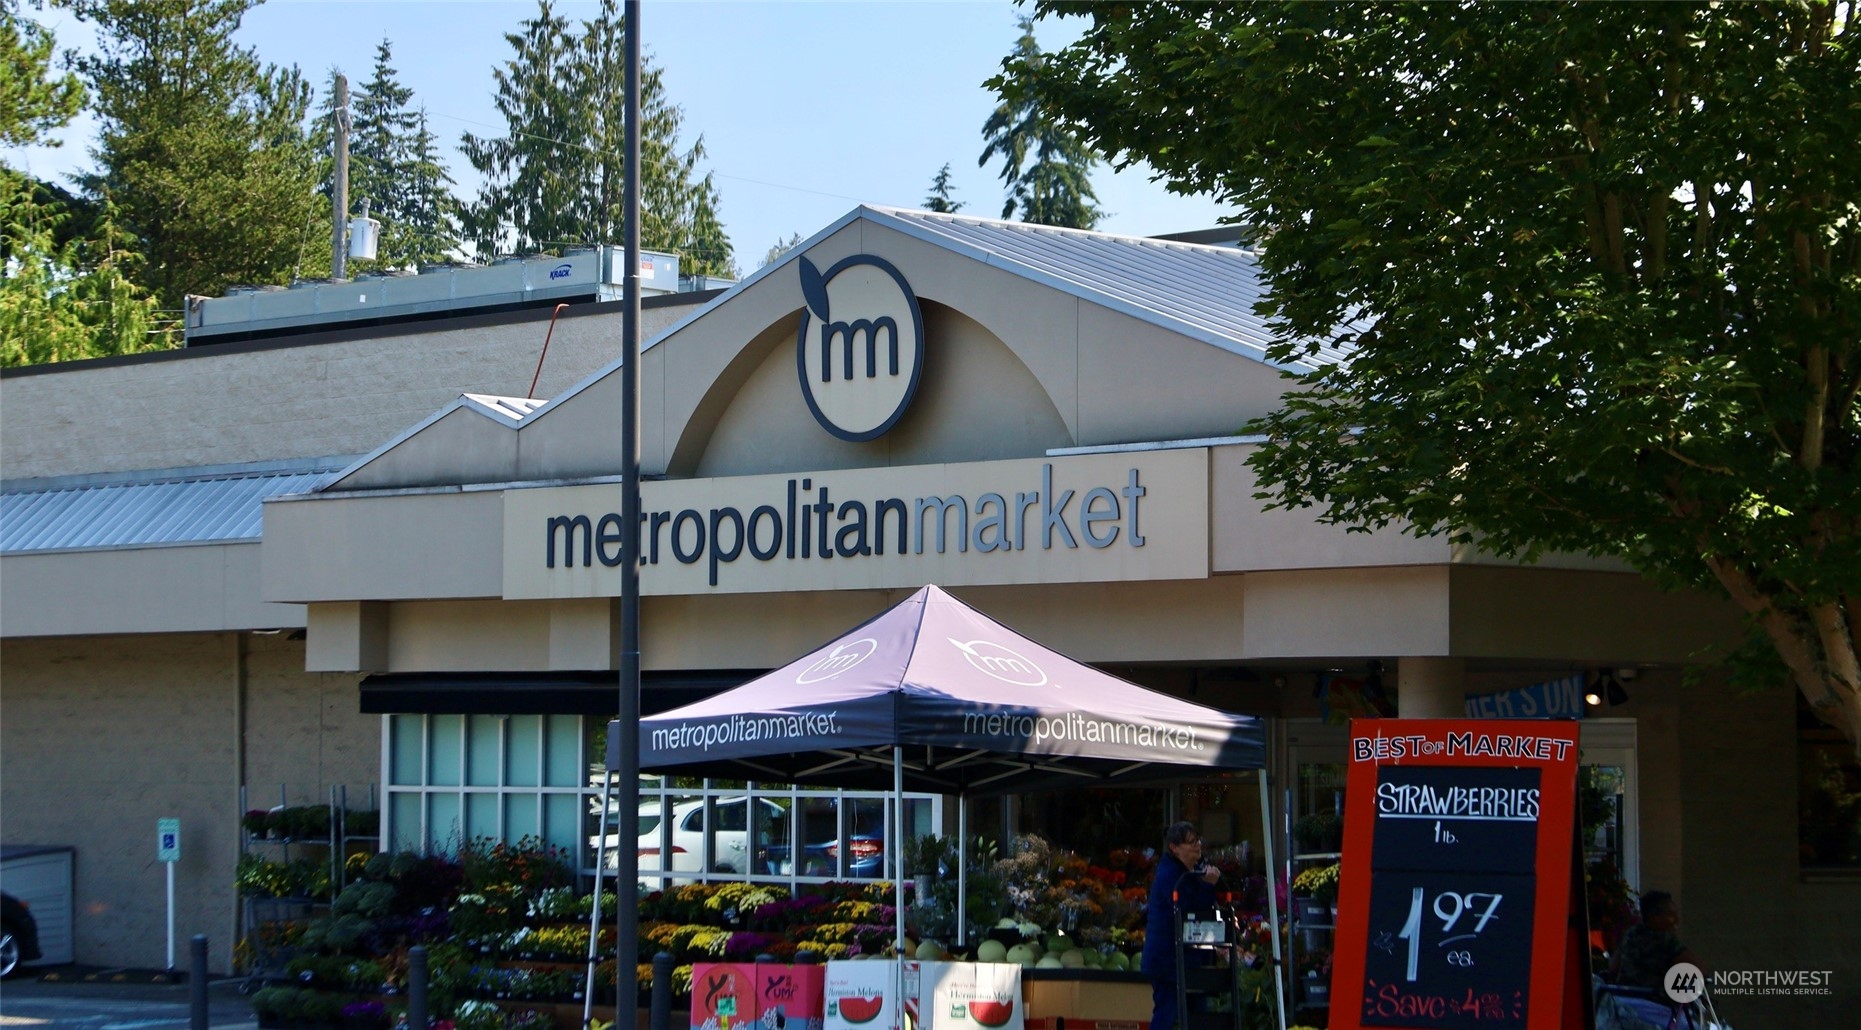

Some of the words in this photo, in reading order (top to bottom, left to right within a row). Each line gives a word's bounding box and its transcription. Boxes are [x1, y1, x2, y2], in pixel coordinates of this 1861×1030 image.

[550, 268, 571, 280] KRACK
[1353, 735, 1425, 762] BEST
[1422, 741, 1444, 755] OF
[1447, 731, 1573, 761] MARKET
[1377, 782, 1540, 818] STRAWBERRIES
[1377, 983, 1445, 1019] Save
